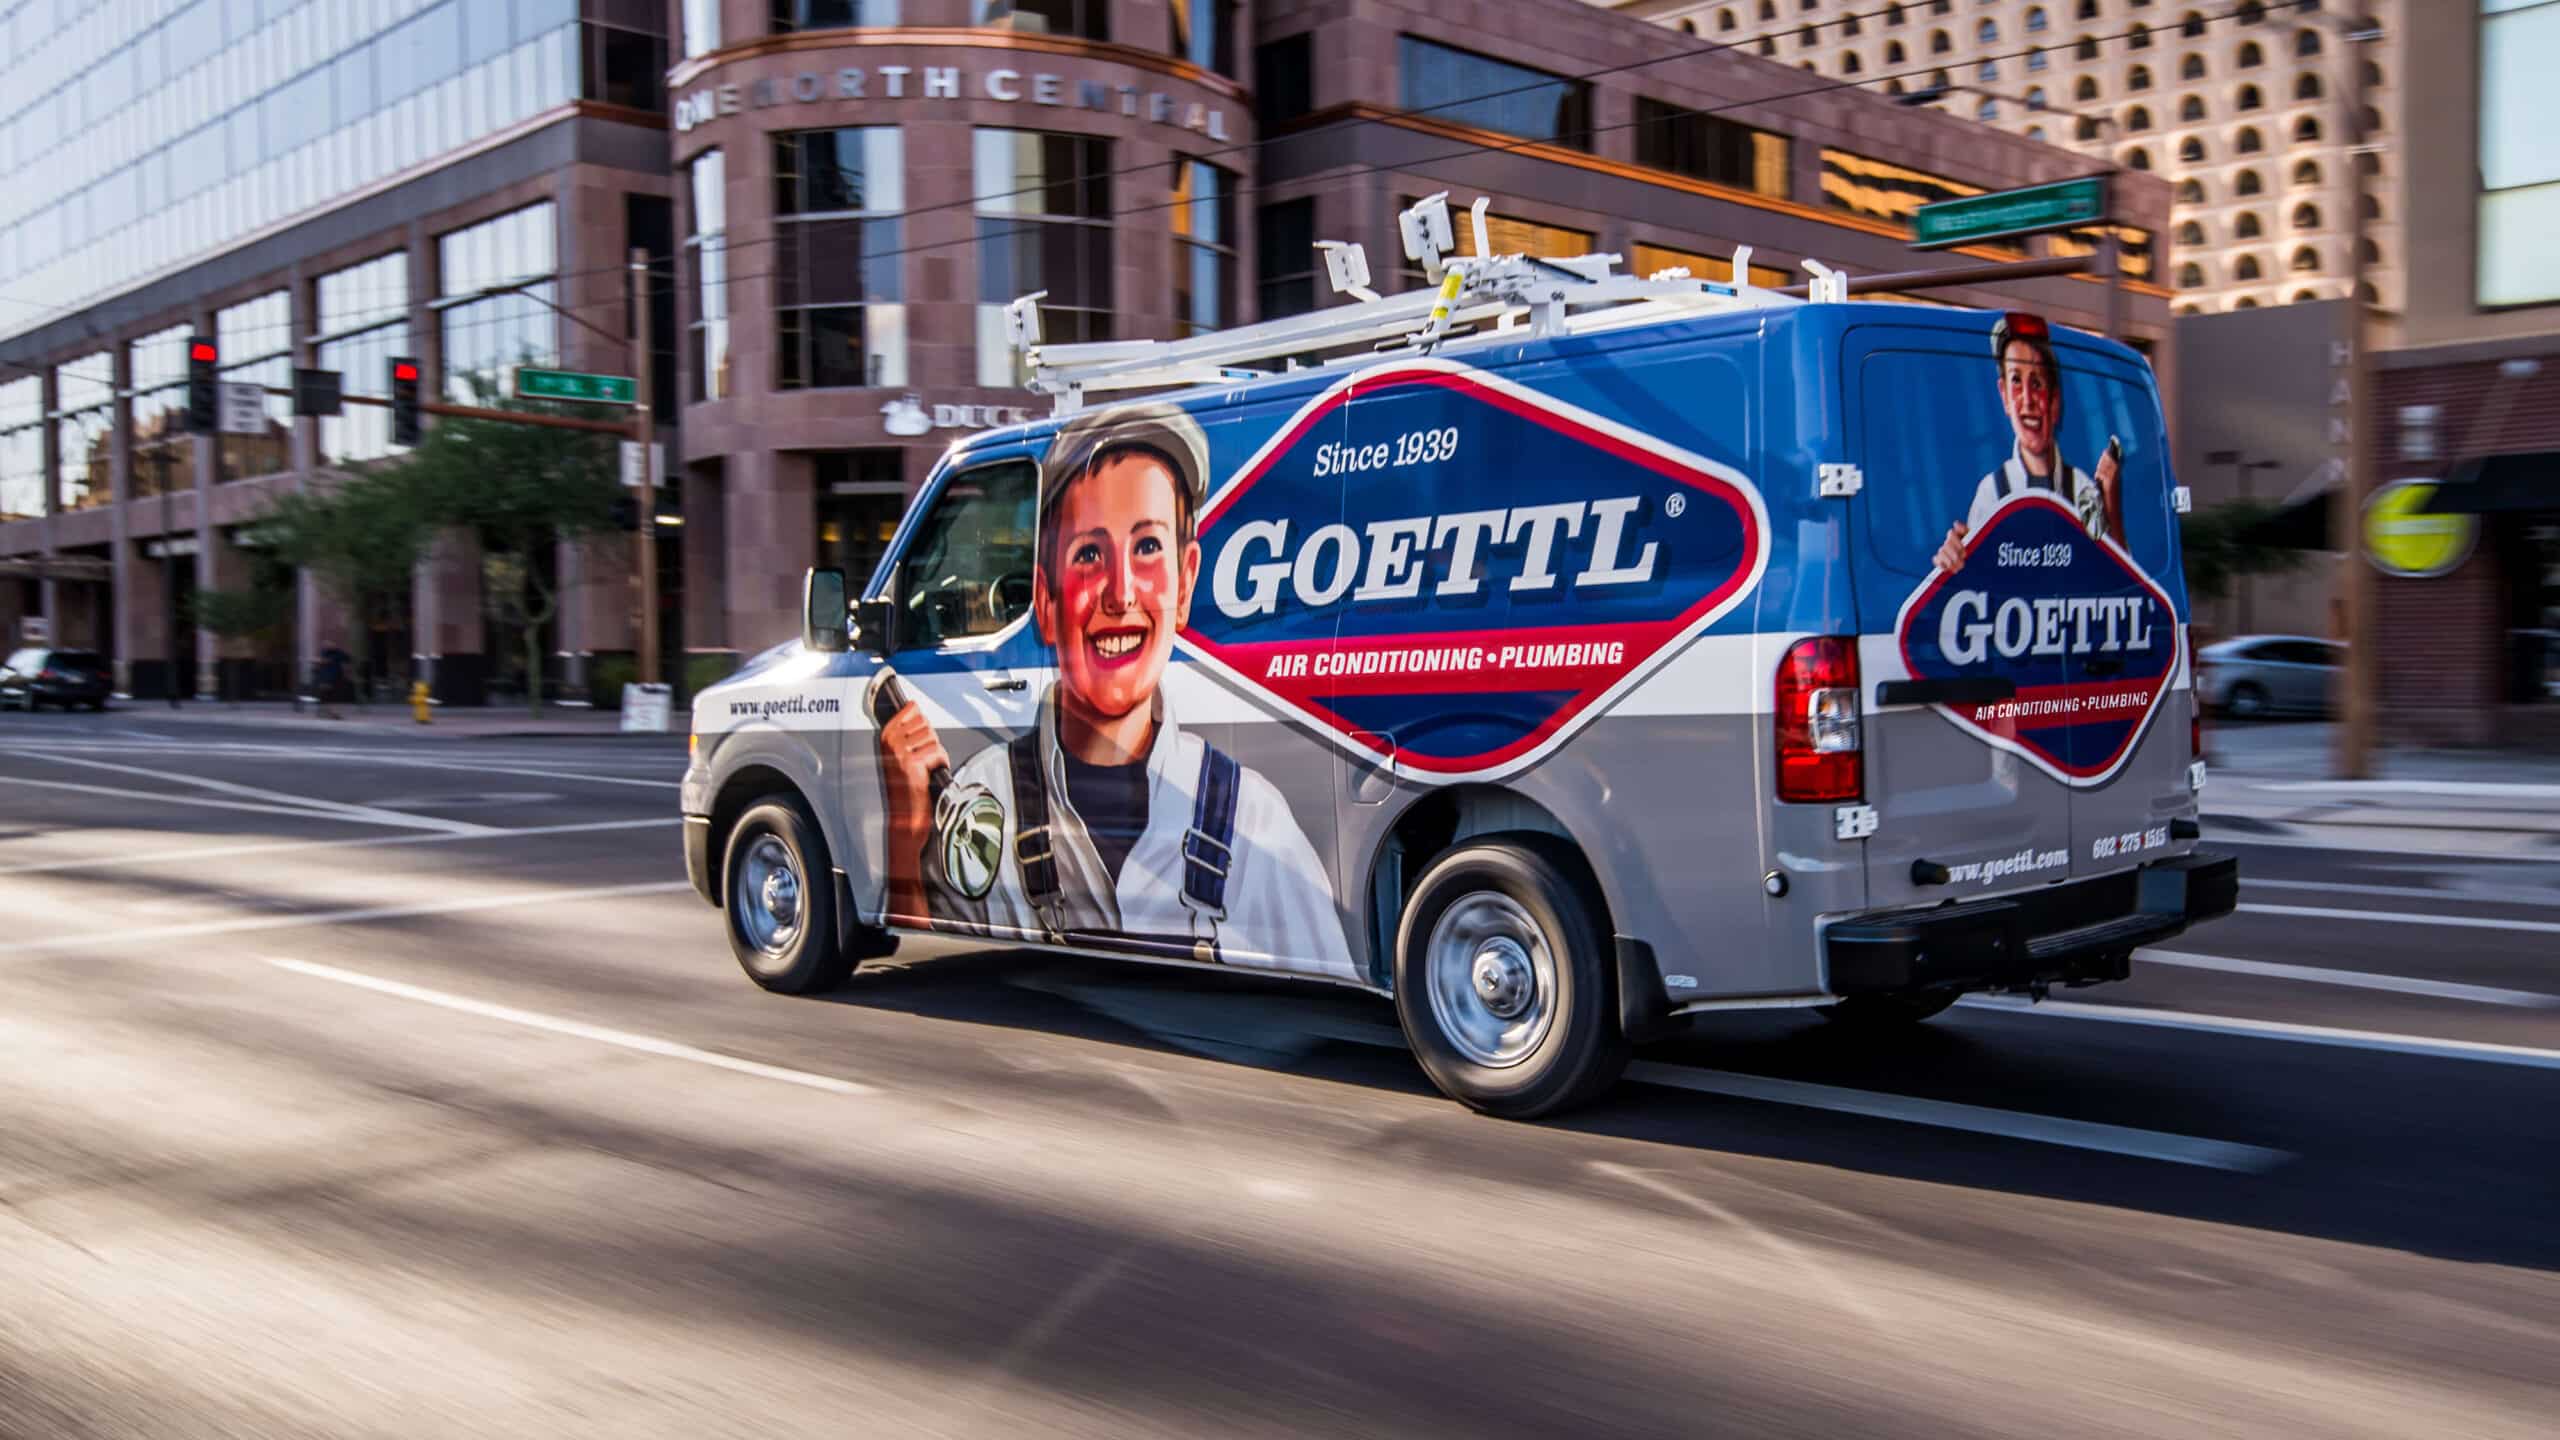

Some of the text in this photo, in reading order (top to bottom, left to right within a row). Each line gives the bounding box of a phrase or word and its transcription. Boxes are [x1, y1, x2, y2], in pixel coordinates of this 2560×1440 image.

[674, 66, 1232, 142] ONE NORTH CENTRAL
[1313, 427, 1459, 477] Since 1939
[1998, 542, 2072, 567] Since 1939
[1939, 590, 2152, 665] GOETTL
[1266, 642, 1624, 677] AIR CONDITIONING PLUMBING
[730, 694, 840, 721] www.goettl.com
[1975, 691, 2148, 721] AIR CONDITIONING PLUMBING
[2093, 826, 2167, 859] 602 275 1515
[1947, 848, 2069, 885] ww.goettl.com
